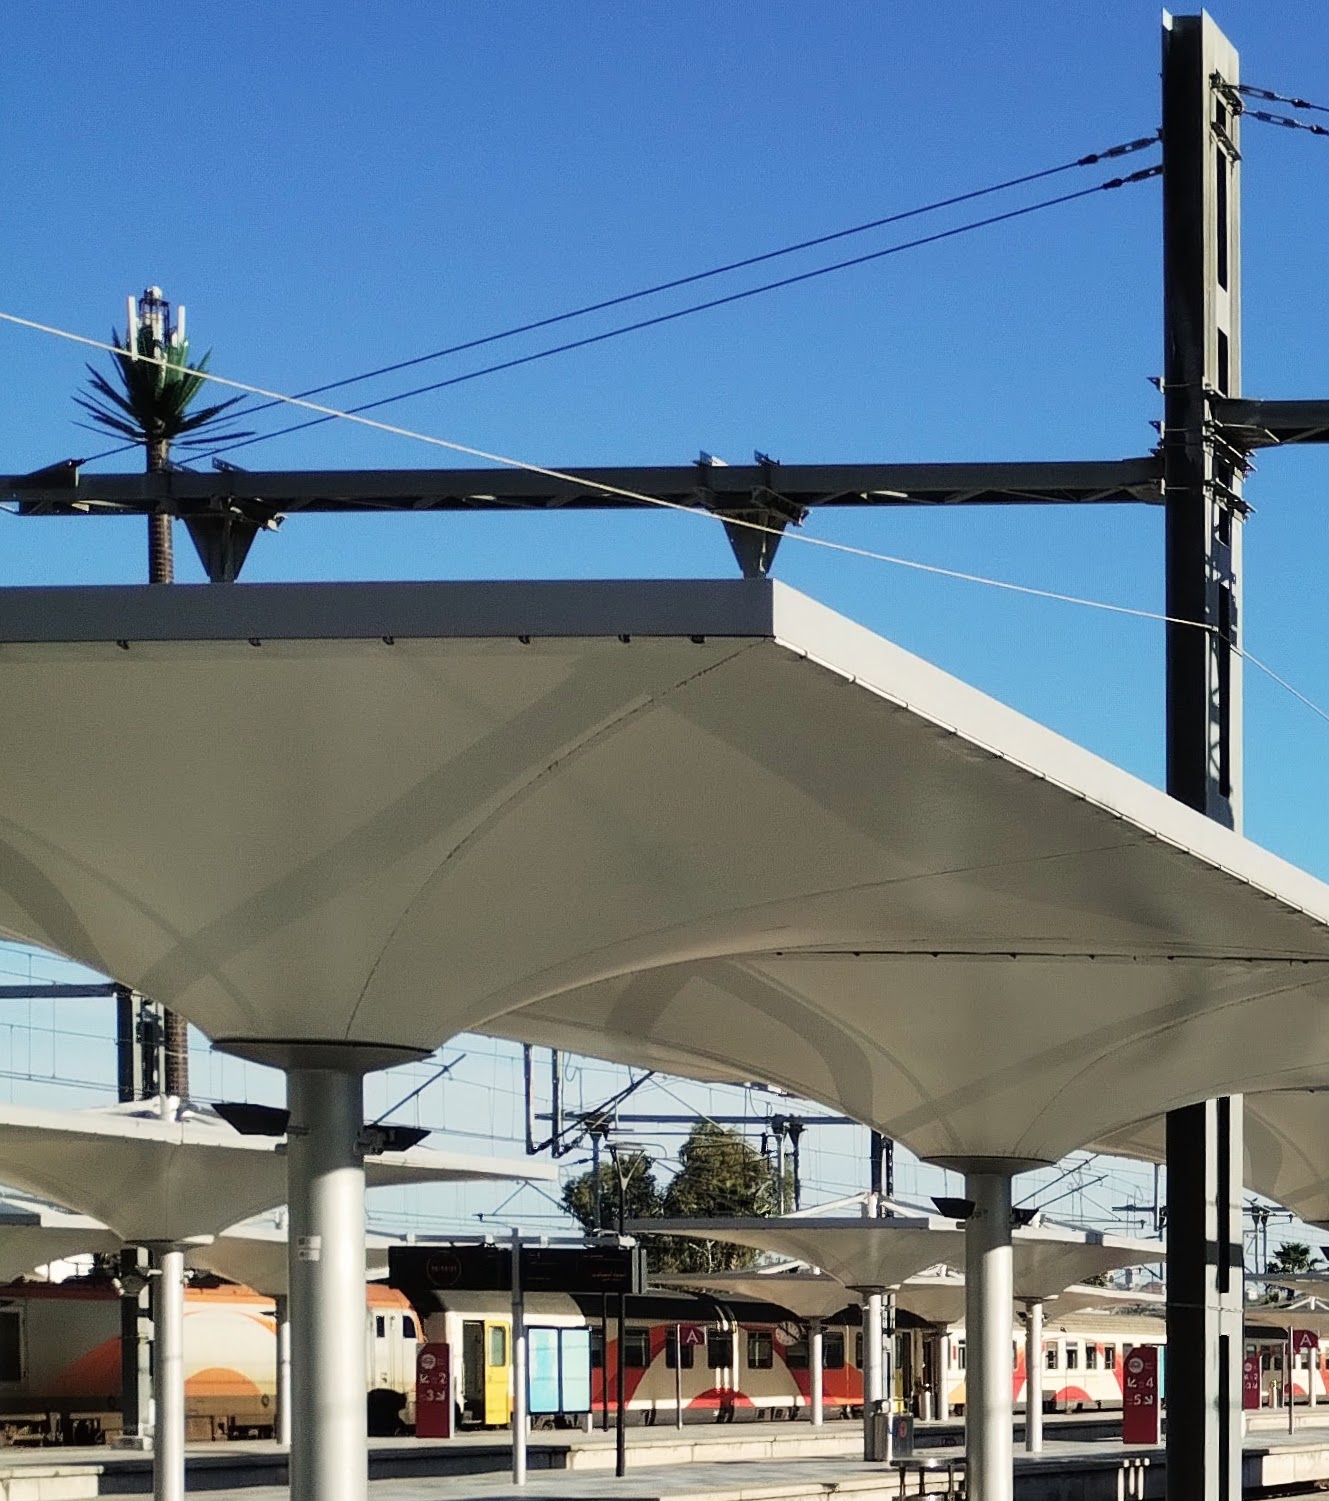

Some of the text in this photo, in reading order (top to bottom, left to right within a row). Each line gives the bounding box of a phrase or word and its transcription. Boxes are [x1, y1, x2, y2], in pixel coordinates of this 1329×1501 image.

[686, 1329, 699, 1343] A
[1299, 1334, 1312, 1346] A
[1145, 1377, 1153, 1388] 4
[1133, 1394, 1142, 1405] 5
